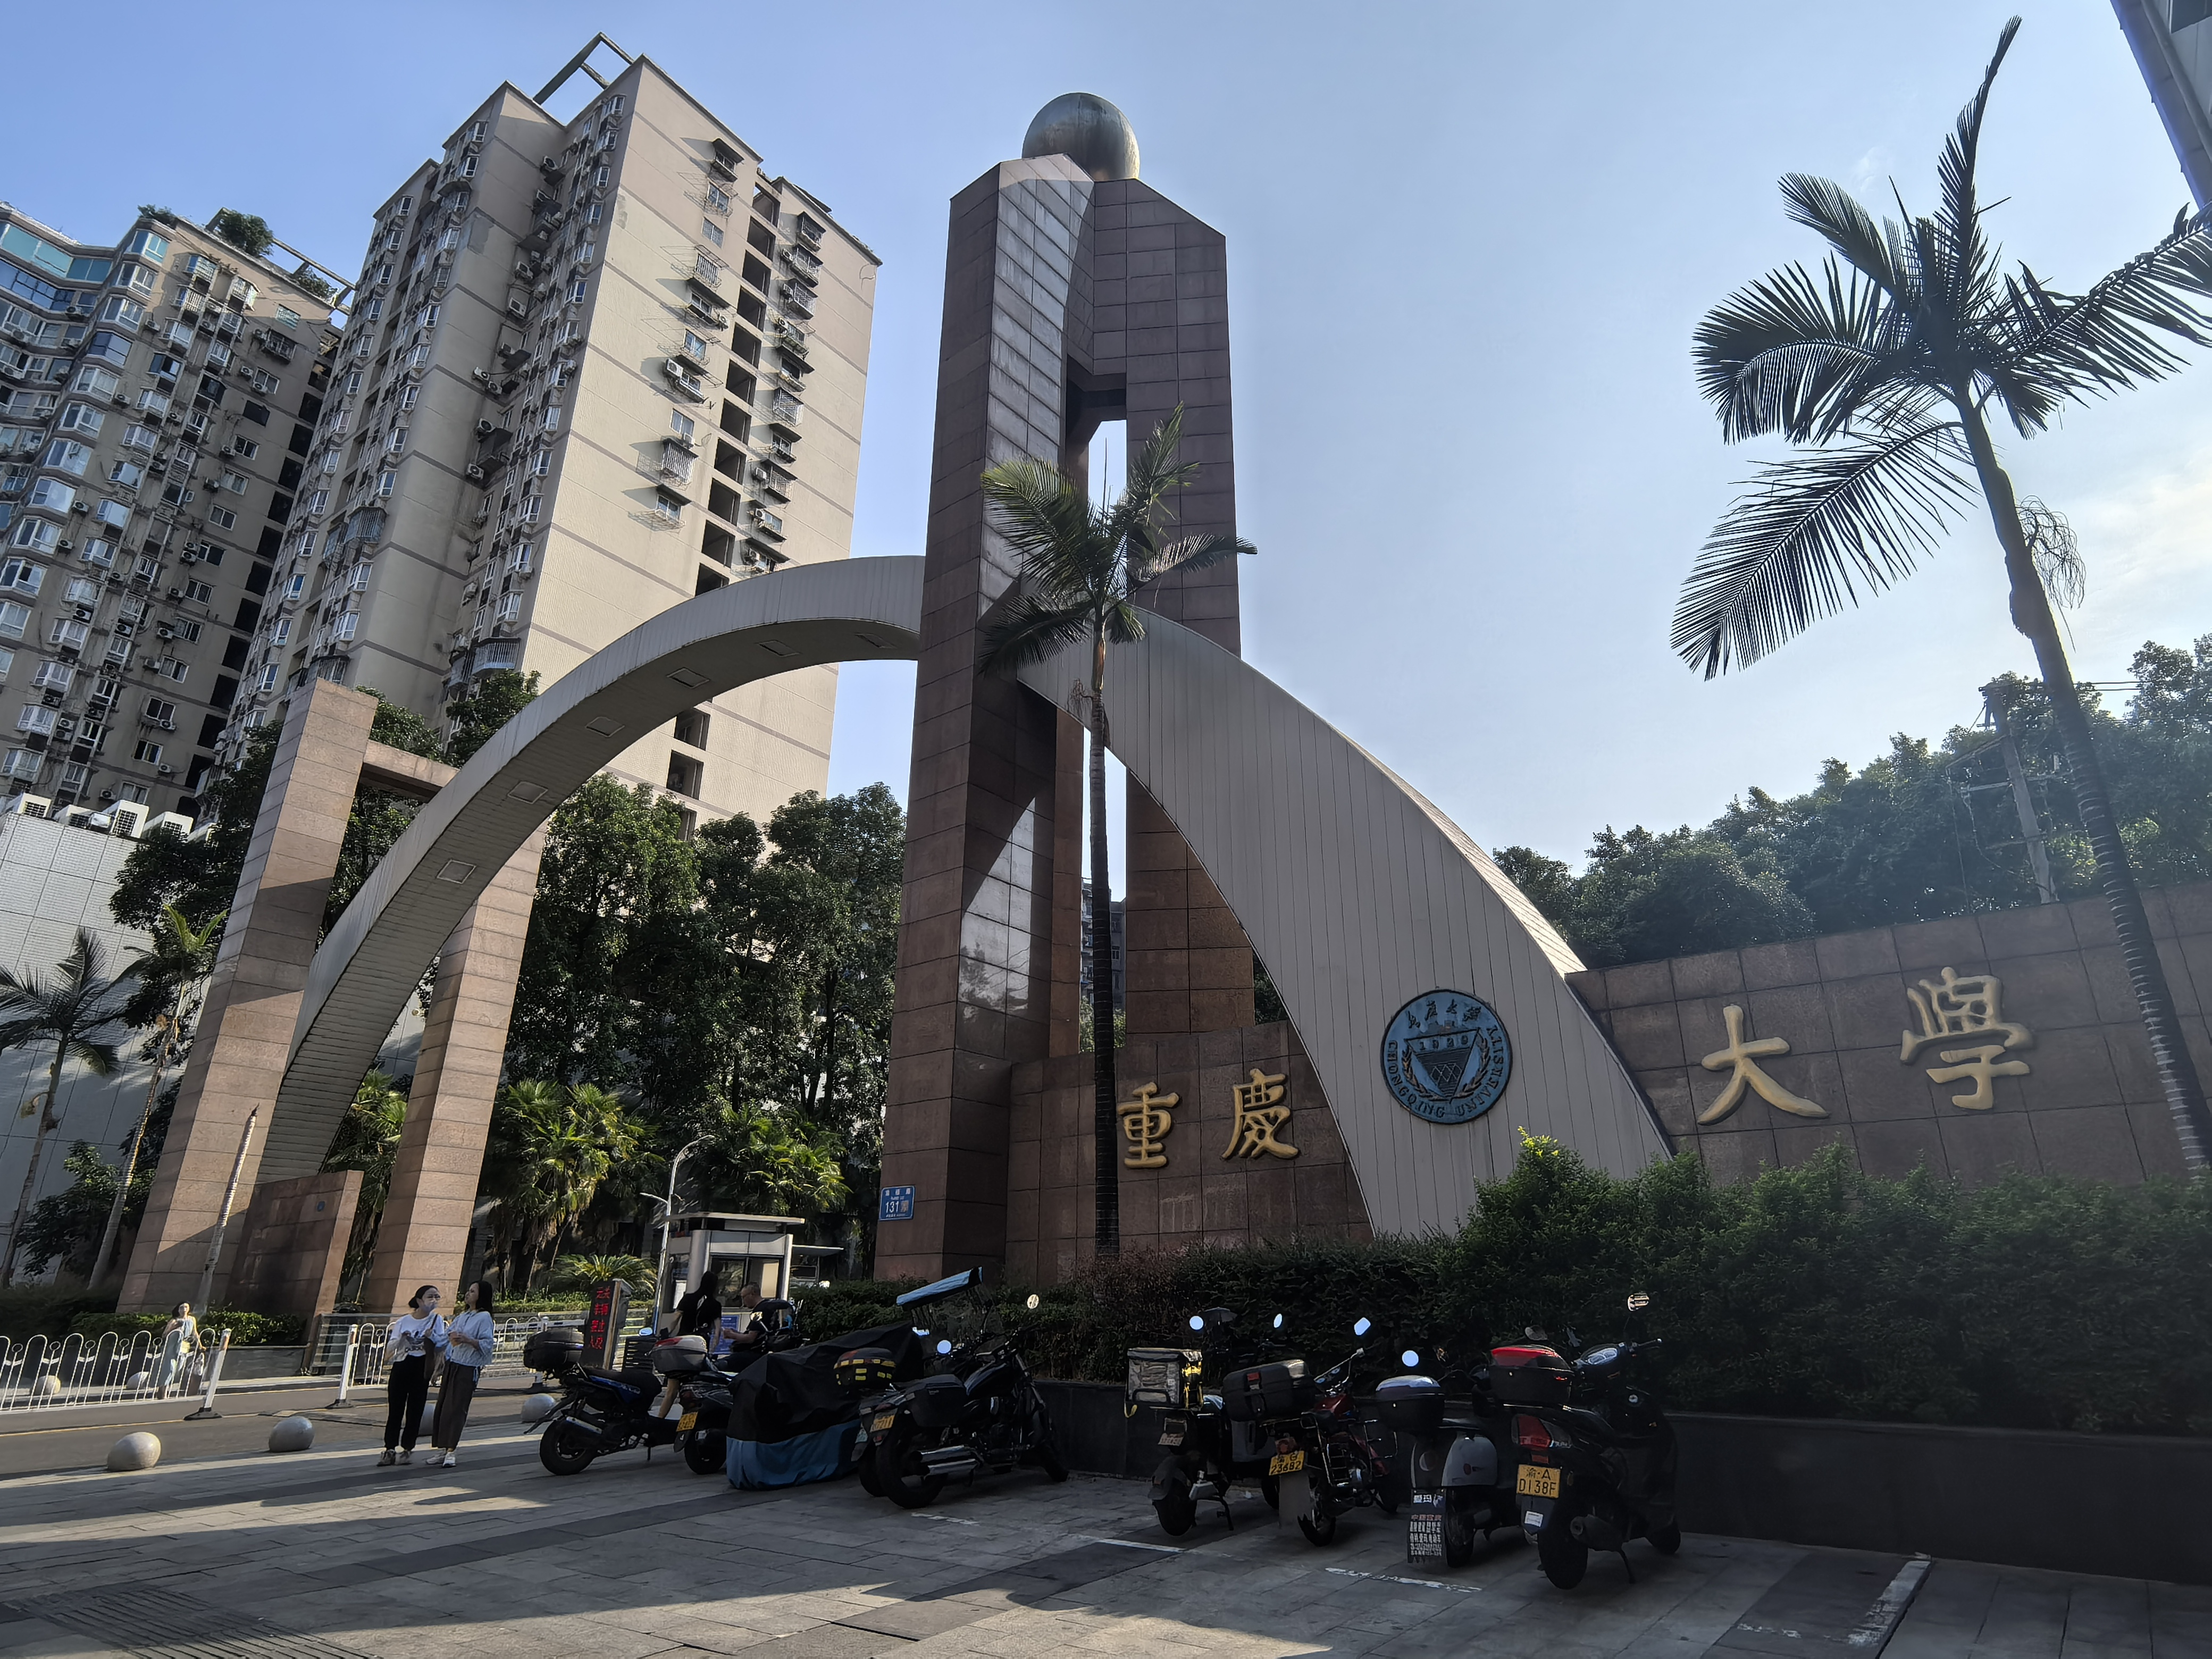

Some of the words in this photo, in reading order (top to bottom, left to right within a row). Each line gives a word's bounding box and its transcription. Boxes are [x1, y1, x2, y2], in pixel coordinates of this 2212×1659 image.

[1387, 1040, 1445, 1118] CHONGQING
[1455, 1025, 1504, 1116] UNIVERSITY
[1519, 1479, 1556, 1495] D138F
